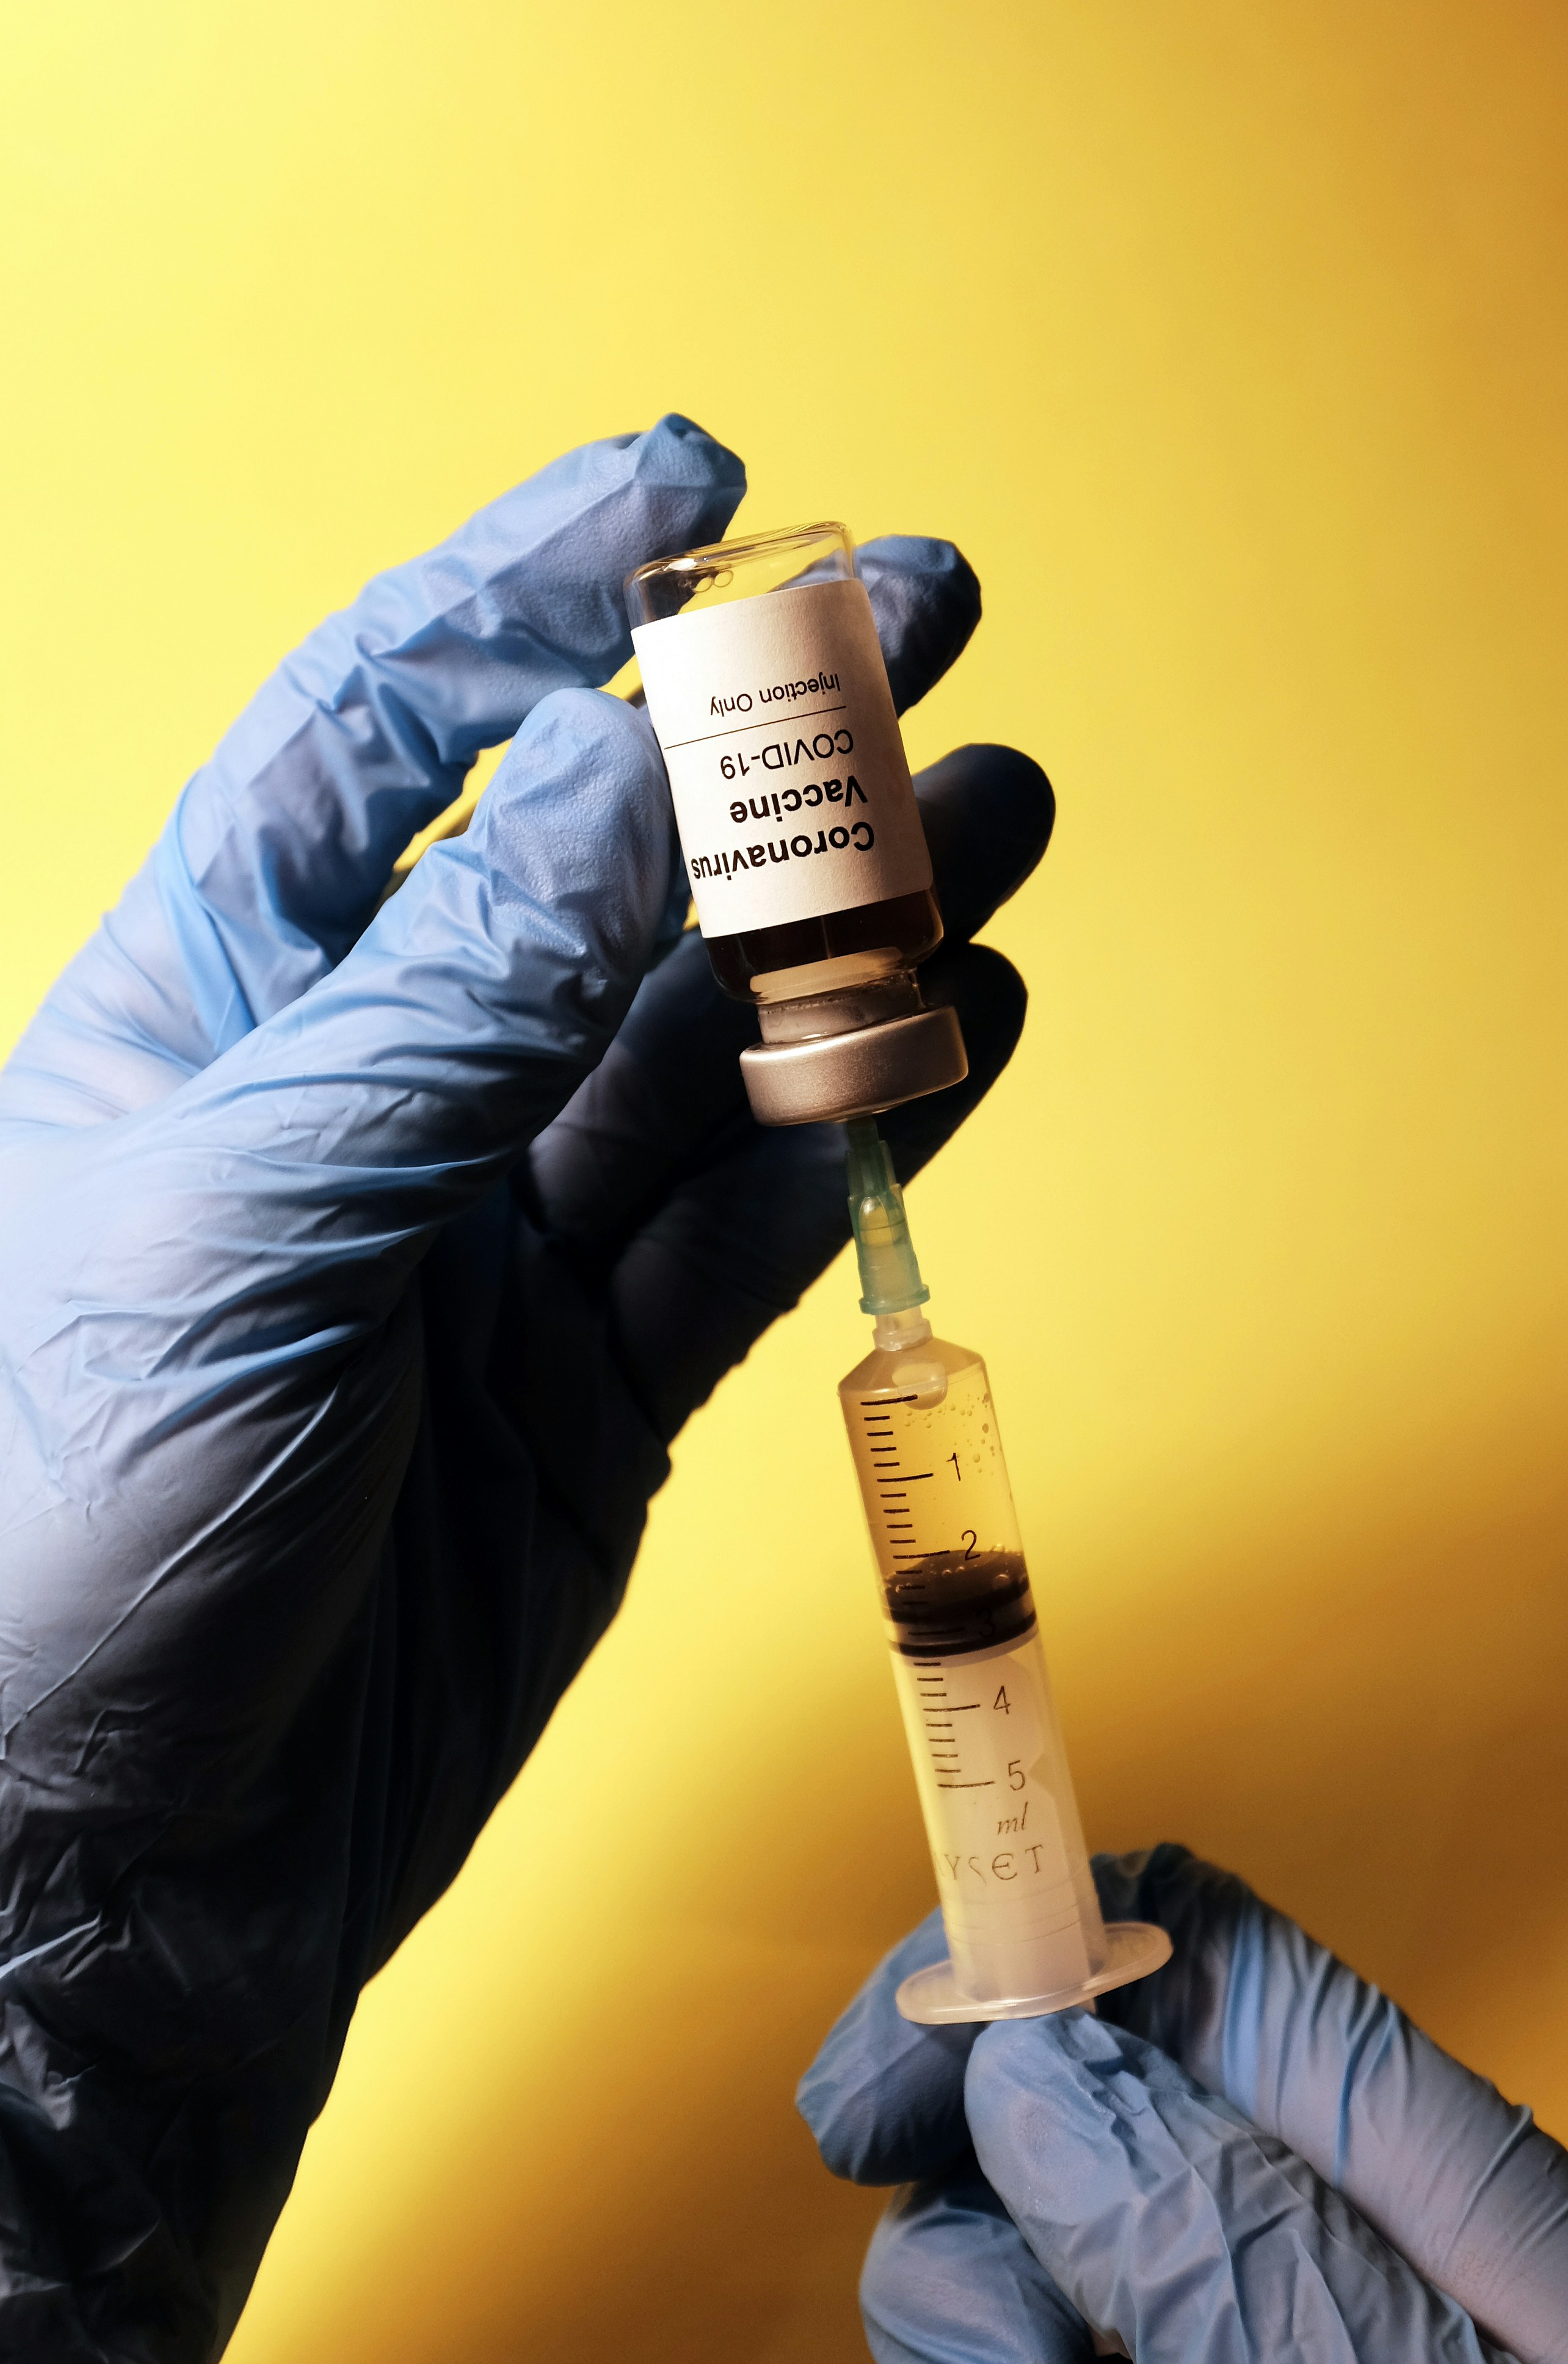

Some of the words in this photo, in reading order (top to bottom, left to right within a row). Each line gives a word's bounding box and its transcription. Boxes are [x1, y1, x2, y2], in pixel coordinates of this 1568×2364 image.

[758, 673, 841, 703] Injection
[710, 693, 753, 717] Only
[720, 729, 854, 780] COVID-19
[729, 775, 869, 824] Vaccine
[691, 821, 875, 881] Coronavirus
[946, 1452, 962, 1481] 1
[961, 1529, 981, 1561] 2
[978, 1607, 995, 1638] 3
[993, 1685, 1011, 1714] 4
[1007, 1760, 1026, 1791] 5
[997, 1802, 1029, 1835] ml
